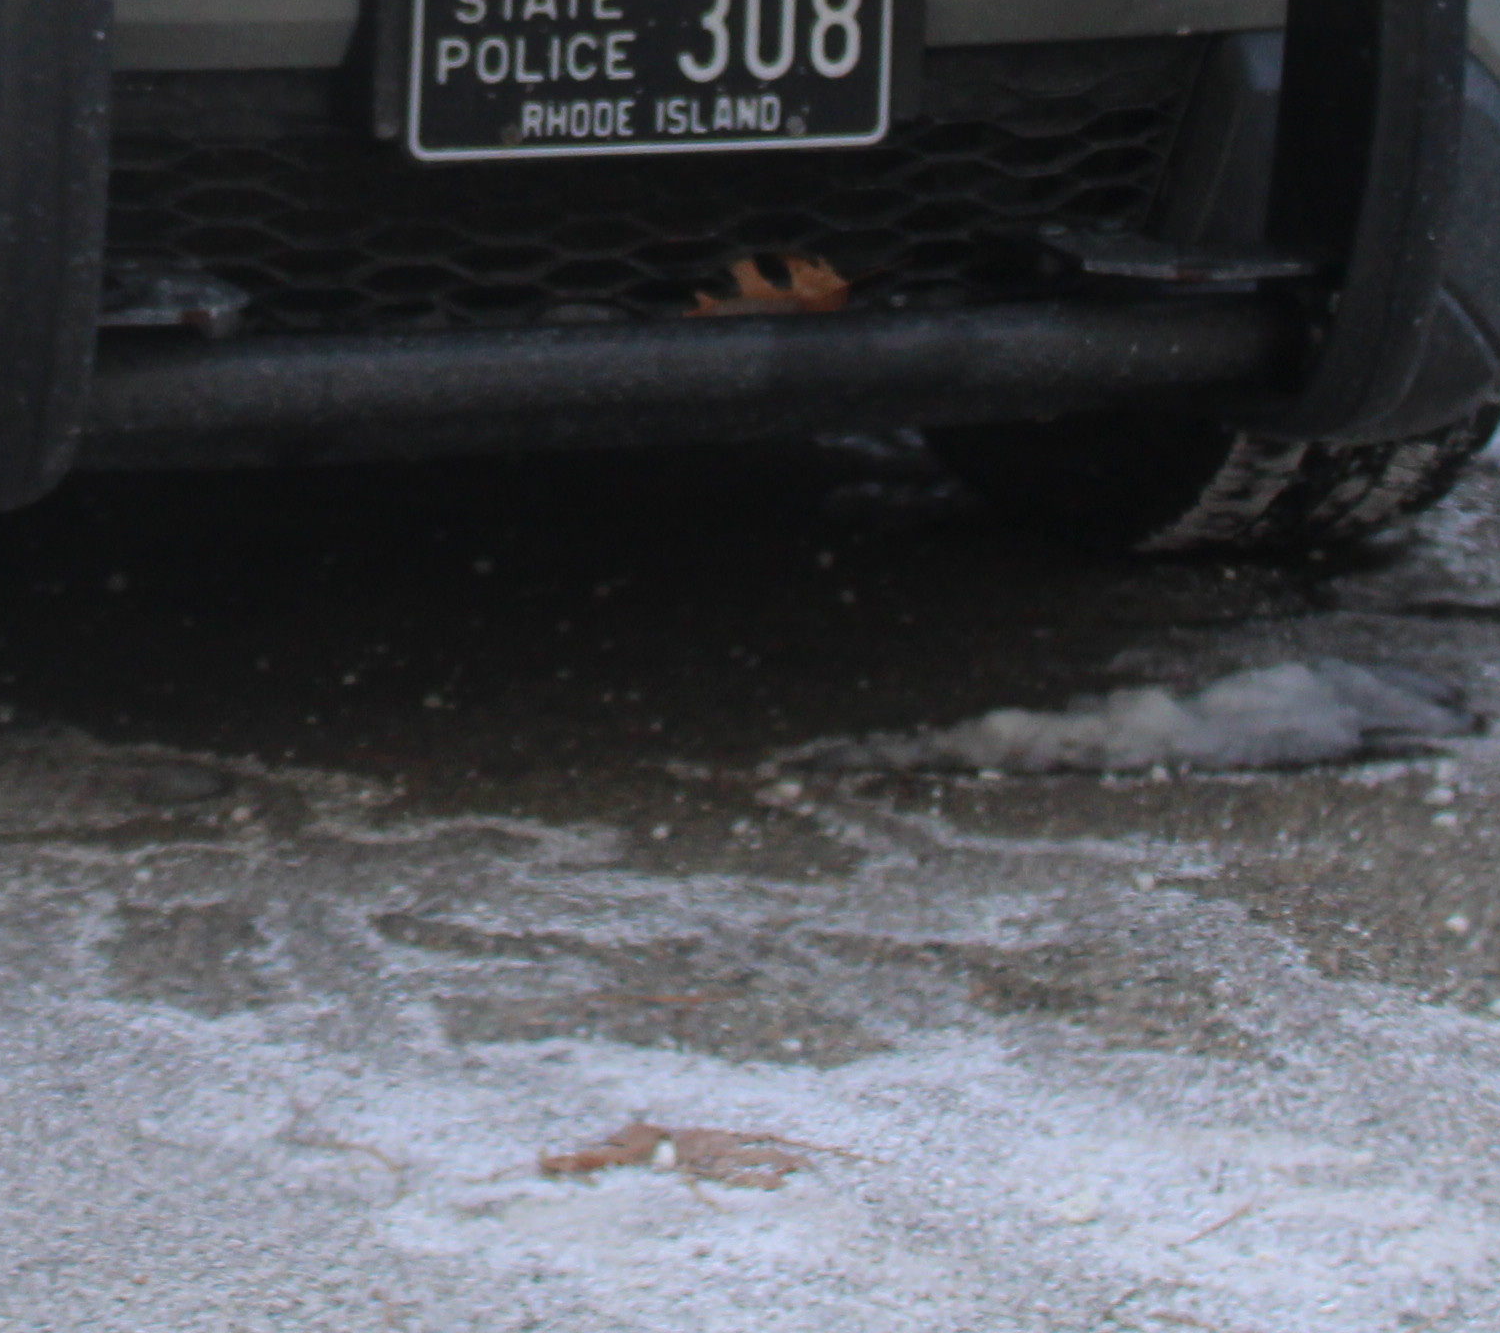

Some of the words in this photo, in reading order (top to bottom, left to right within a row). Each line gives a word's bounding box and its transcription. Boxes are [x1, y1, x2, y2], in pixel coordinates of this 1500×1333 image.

[436, 31, 636, 84] POLICE
[521, 99, 635, 138] RHODE
[656, 94, 781, 135] ISLAND
